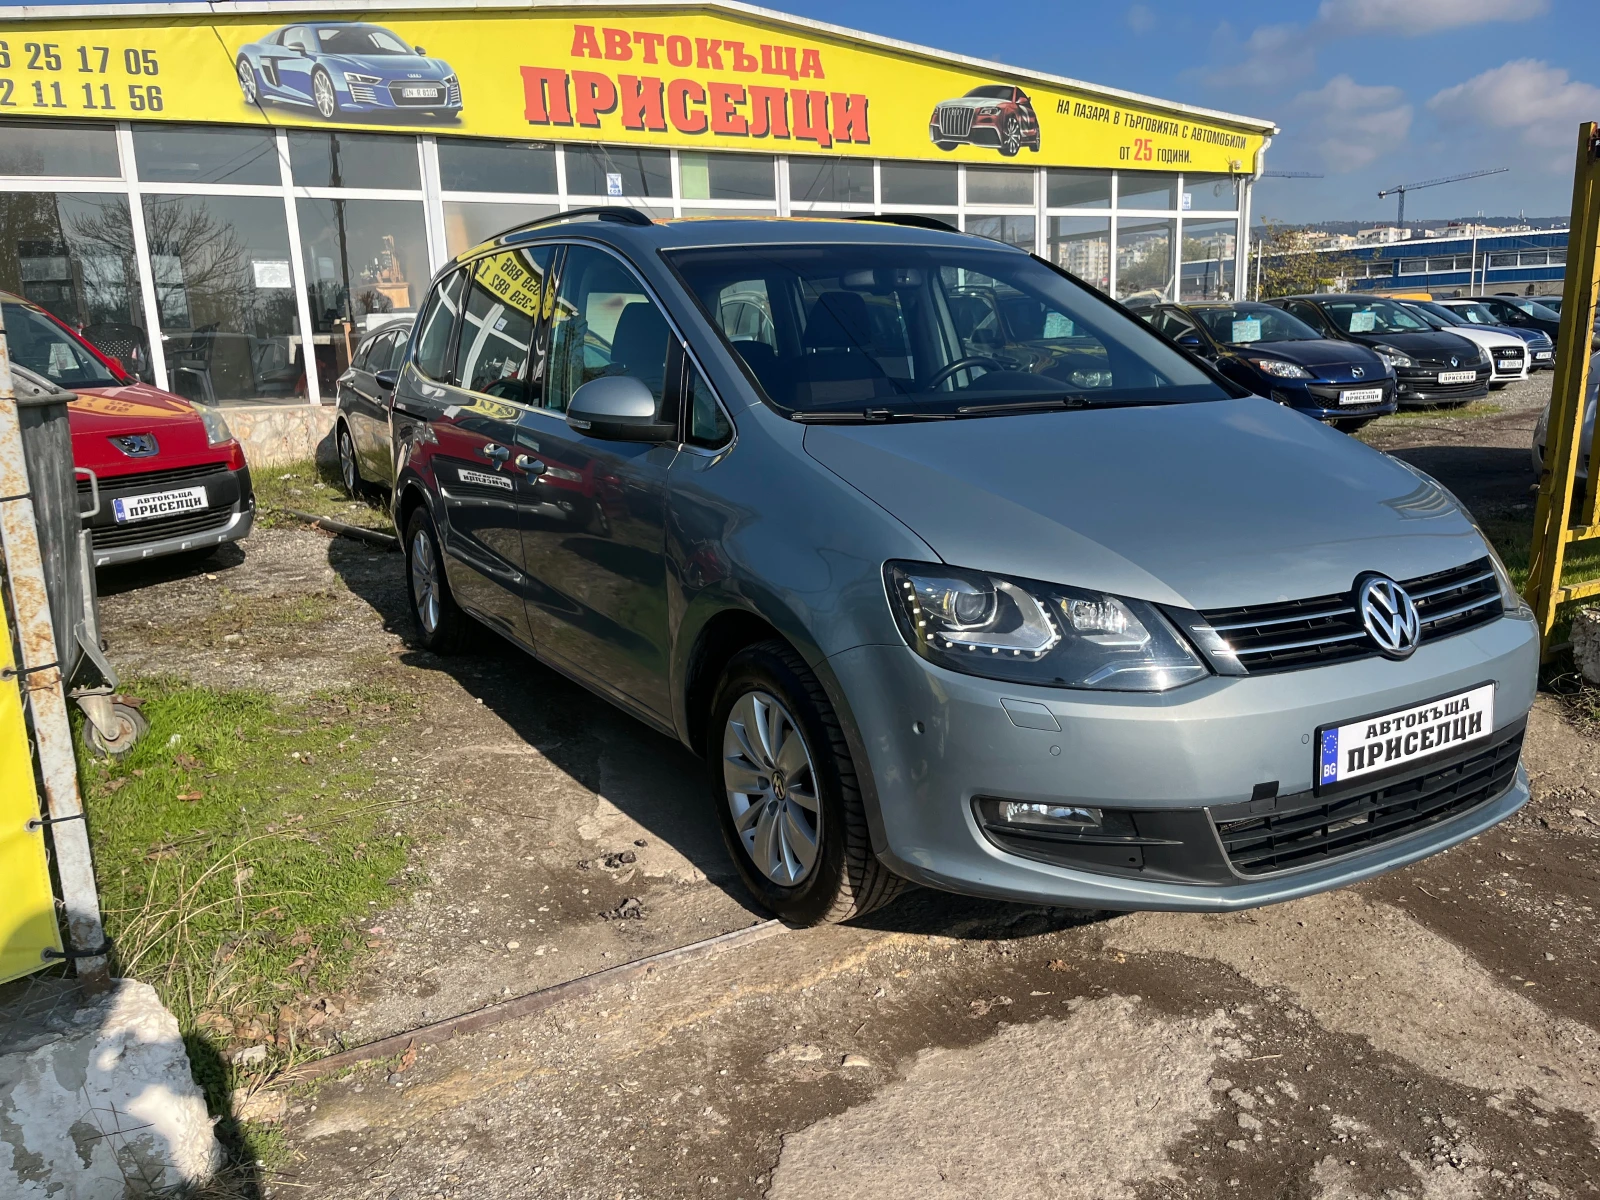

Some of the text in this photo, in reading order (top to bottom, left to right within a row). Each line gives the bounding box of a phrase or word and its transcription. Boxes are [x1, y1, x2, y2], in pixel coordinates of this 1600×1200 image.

[24, 42, 62, 71] 25
[76, 45, 110, 74] 17
[123, 48, 159, 76] 05
[570, 24, 826, 81] АВТОКЪЩА
[31, 80, 67, 108] 11
[81, 82, 116, 110] 11
[128, 84, 164, 112] 56
[520, 65, 870, 149] ПРИСЕЛЦИ
[1056, 99, 1247, 150] НА ПАЗАРА В ТЪРГОВИЯТА С АВТОМОБИЛИ
[1119, 138, 1192, 164] ОТ 25 ГОДИНИ.
[1345, 393, 1379, 402] ПРИСЕЛЦИ
[129, 496, 203, 517] ПРИСЕЛЦИ
[136, 490, 194, 505] АВТОКЪЩА
[1365, 697, 1470, 740] АВТОКЪЩА
[1346, 710, 1483, 773] ПРИСЕЛЦИ
[1323, 762, 1337, 778] BG
